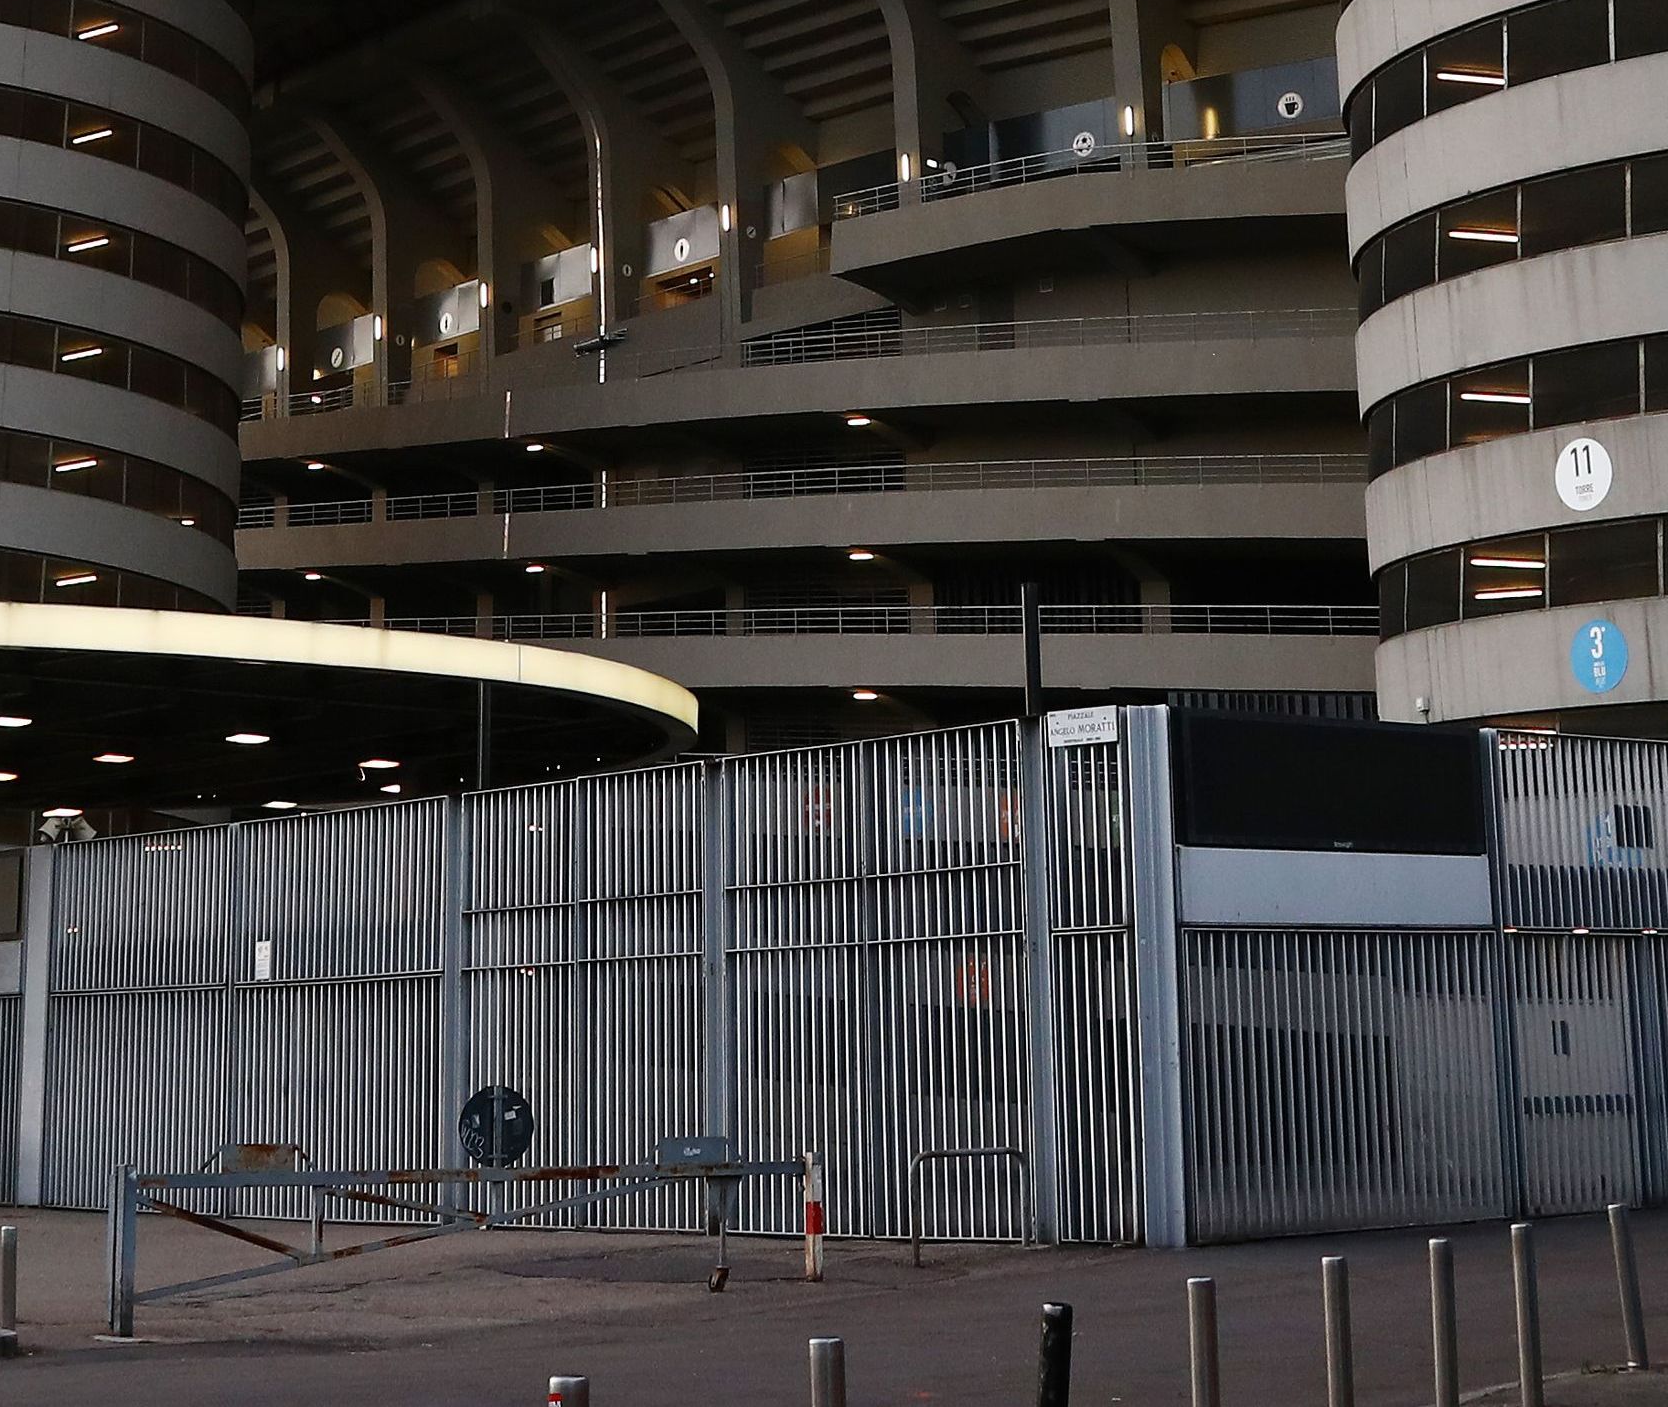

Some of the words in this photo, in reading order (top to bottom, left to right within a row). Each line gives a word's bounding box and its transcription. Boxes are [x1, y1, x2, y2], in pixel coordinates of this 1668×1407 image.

[1570, 445, 1591, 477] 11
[1067, 711, 1094, 721] PIAZZALE
[1050, 727, 1076, 737] ANGELO
[1077, 720, 1115, 734] MORATTI
